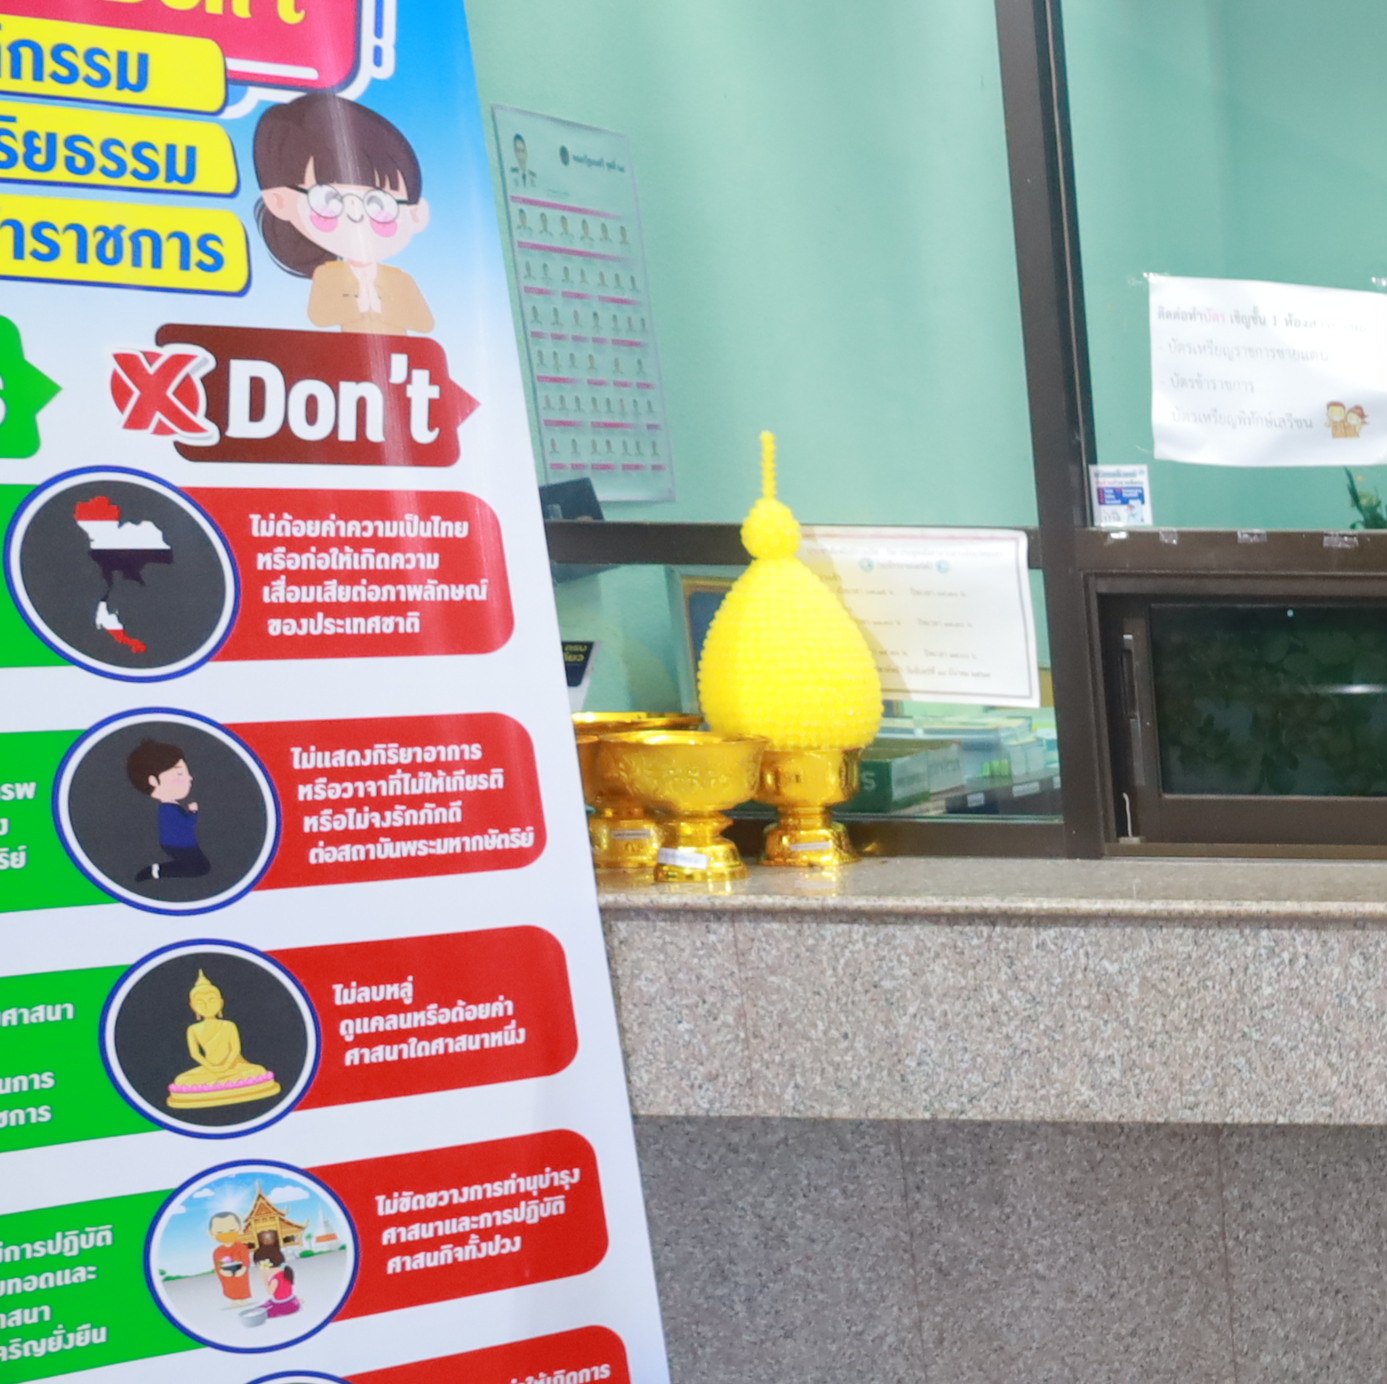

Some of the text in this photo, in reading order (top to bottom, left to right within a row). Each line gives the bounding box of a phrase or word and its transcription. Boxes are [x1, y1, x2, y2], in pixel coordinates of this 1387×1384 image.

[0, 36, 149, 93] กรรม
[0, 218, 225, 273] าราชการ
[226, 353, 440, 444] Don't
[249, 512, 469, 538] ไม่ด้อยค่าความเป็นไทย
[256, 546, 440, 570] หรือก่อให้เกิดความ
[262, 575, 489, 603] เสื่อมเสียต่อภาพลักษณ์
[267, 611, 421, 636] ของประเทศชาติ
[290, 743, 483, 769] ไม่แสดงกิริยาอาการ
[298, 768, 504, 801] หรือวาจาที่ไม่ให้เกียรติ
[303, 800, 463, 833] หรือไม่จงรักภักดี
[308, 826, 535, 864] ต่อสถาบันพระมหากษัตริย์
[332, 975, 414, 1005] ไม่ลบหลู่
[0, 1002, 75, 1027] ศาสนา
[339, 995, 514, 1042] ดูแคลนหรือด้อยค่า
[344, 1019, 526, 1066] ศาสนาใดศาสนาหนึ่ง
[375, 1166, 581, 1216] ไม่ขัดขวางการทำนุบำรุง
[381, 1195, 566, 1246] ศาสนาและการปฏิบัติ
[0, 1224, 113, 1263] การปฏิบัติ
[386, 1233, 522, 1275] ศาสนกิจทั้งปวง
